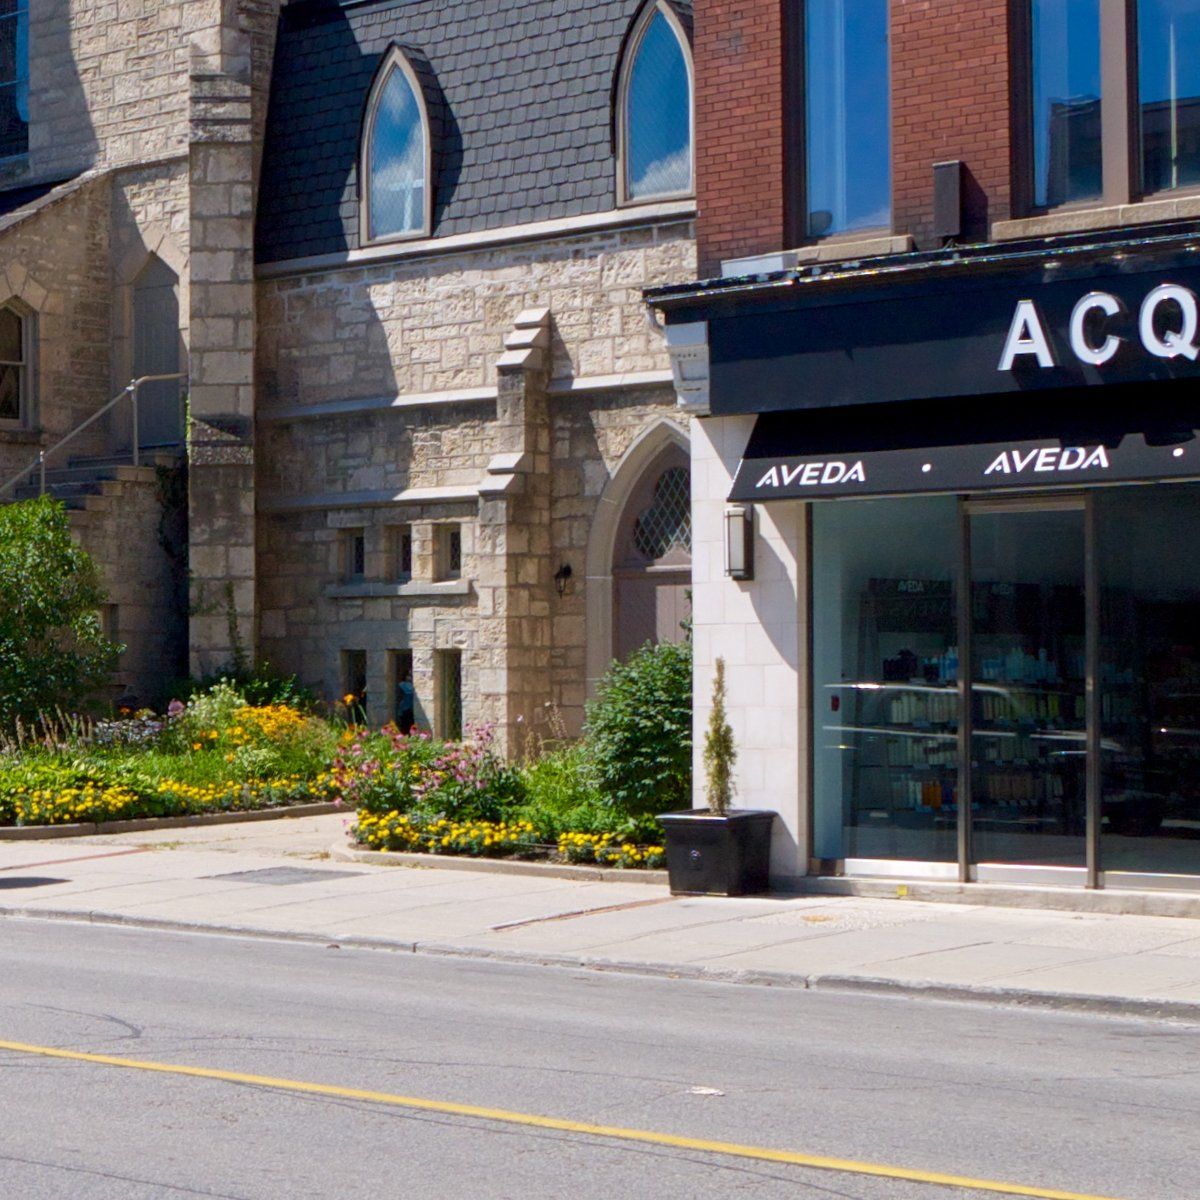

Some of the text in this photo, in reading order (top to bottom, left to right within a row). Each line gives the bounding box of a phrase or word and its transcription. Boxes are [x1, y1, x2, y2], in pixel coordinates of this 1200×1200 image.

[997, 283, 1200, 371] ACQ
[755, 460, 866, 488] AVEDA
[984, 445, 1110, 475] AVEDA
